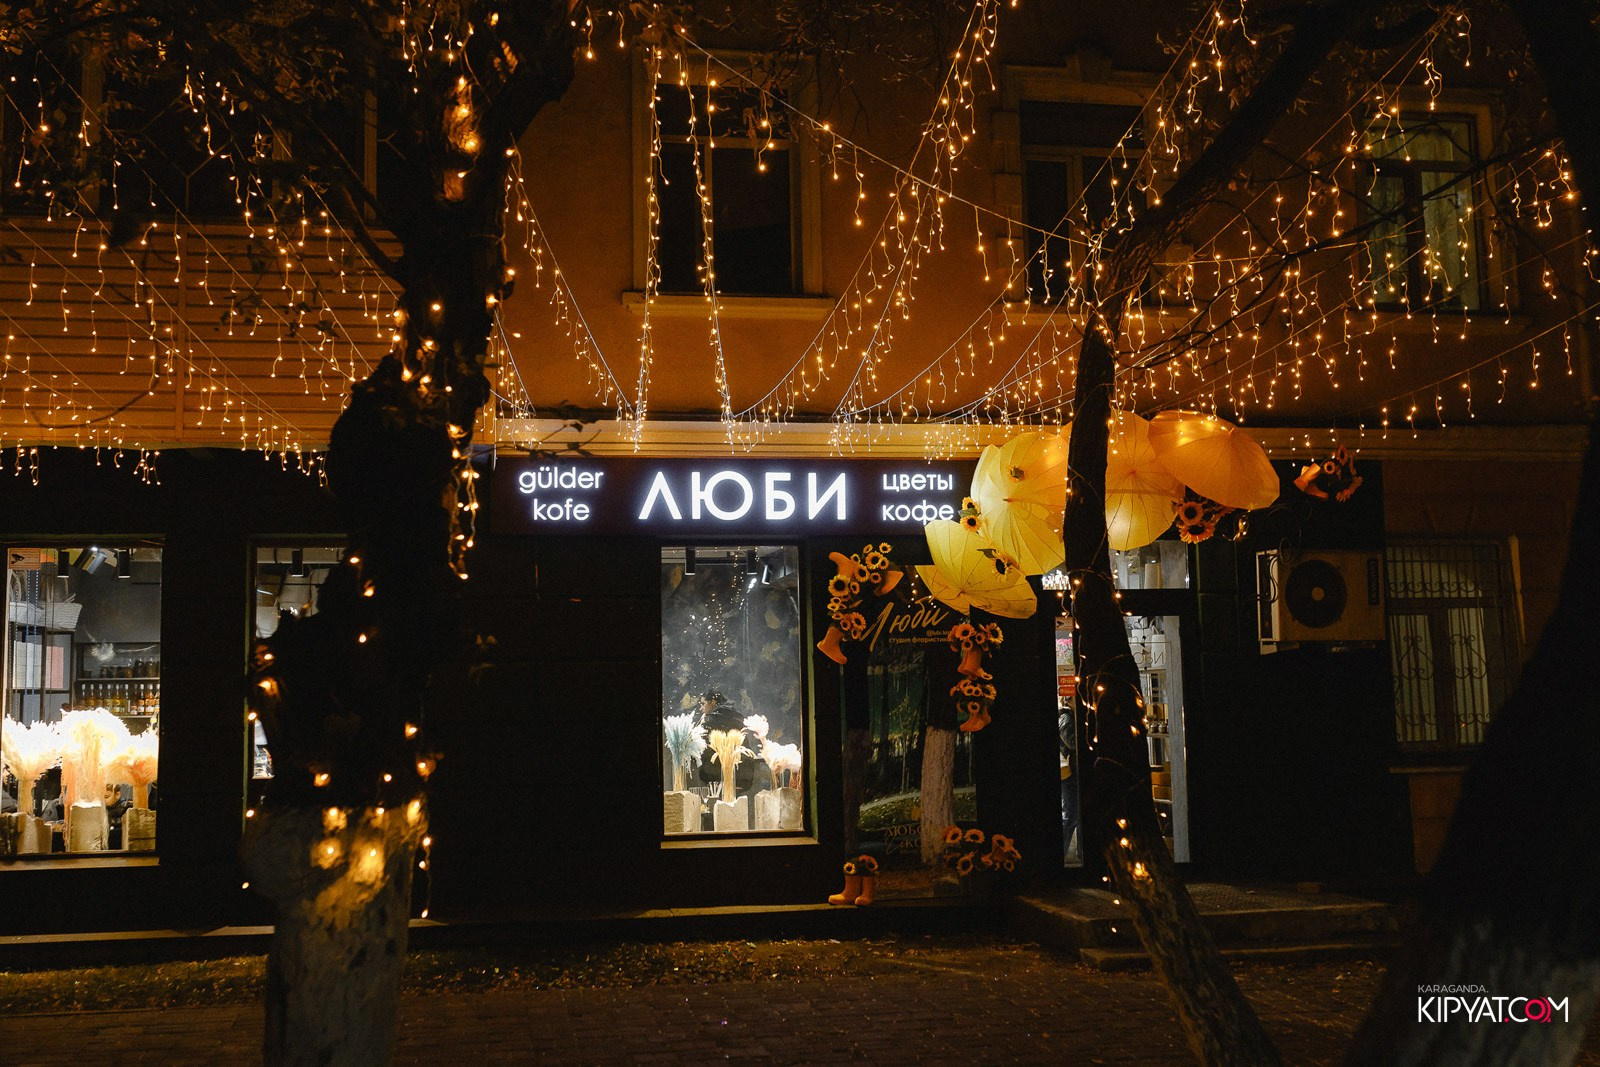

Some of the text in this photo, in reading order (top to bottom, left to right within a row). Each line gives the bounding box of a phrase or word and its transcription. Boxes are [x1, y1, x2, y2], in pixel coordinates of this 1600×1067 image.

[518, 466, 604, 494] gülder
[882, 473, 954, 493] цветы
[533, 498, 590, 521] kofe
[638, 471, 848, 521] ЛЮБИ
[882, 499, 955, 526] кофе
[860, 596, 950, 652] Люби
